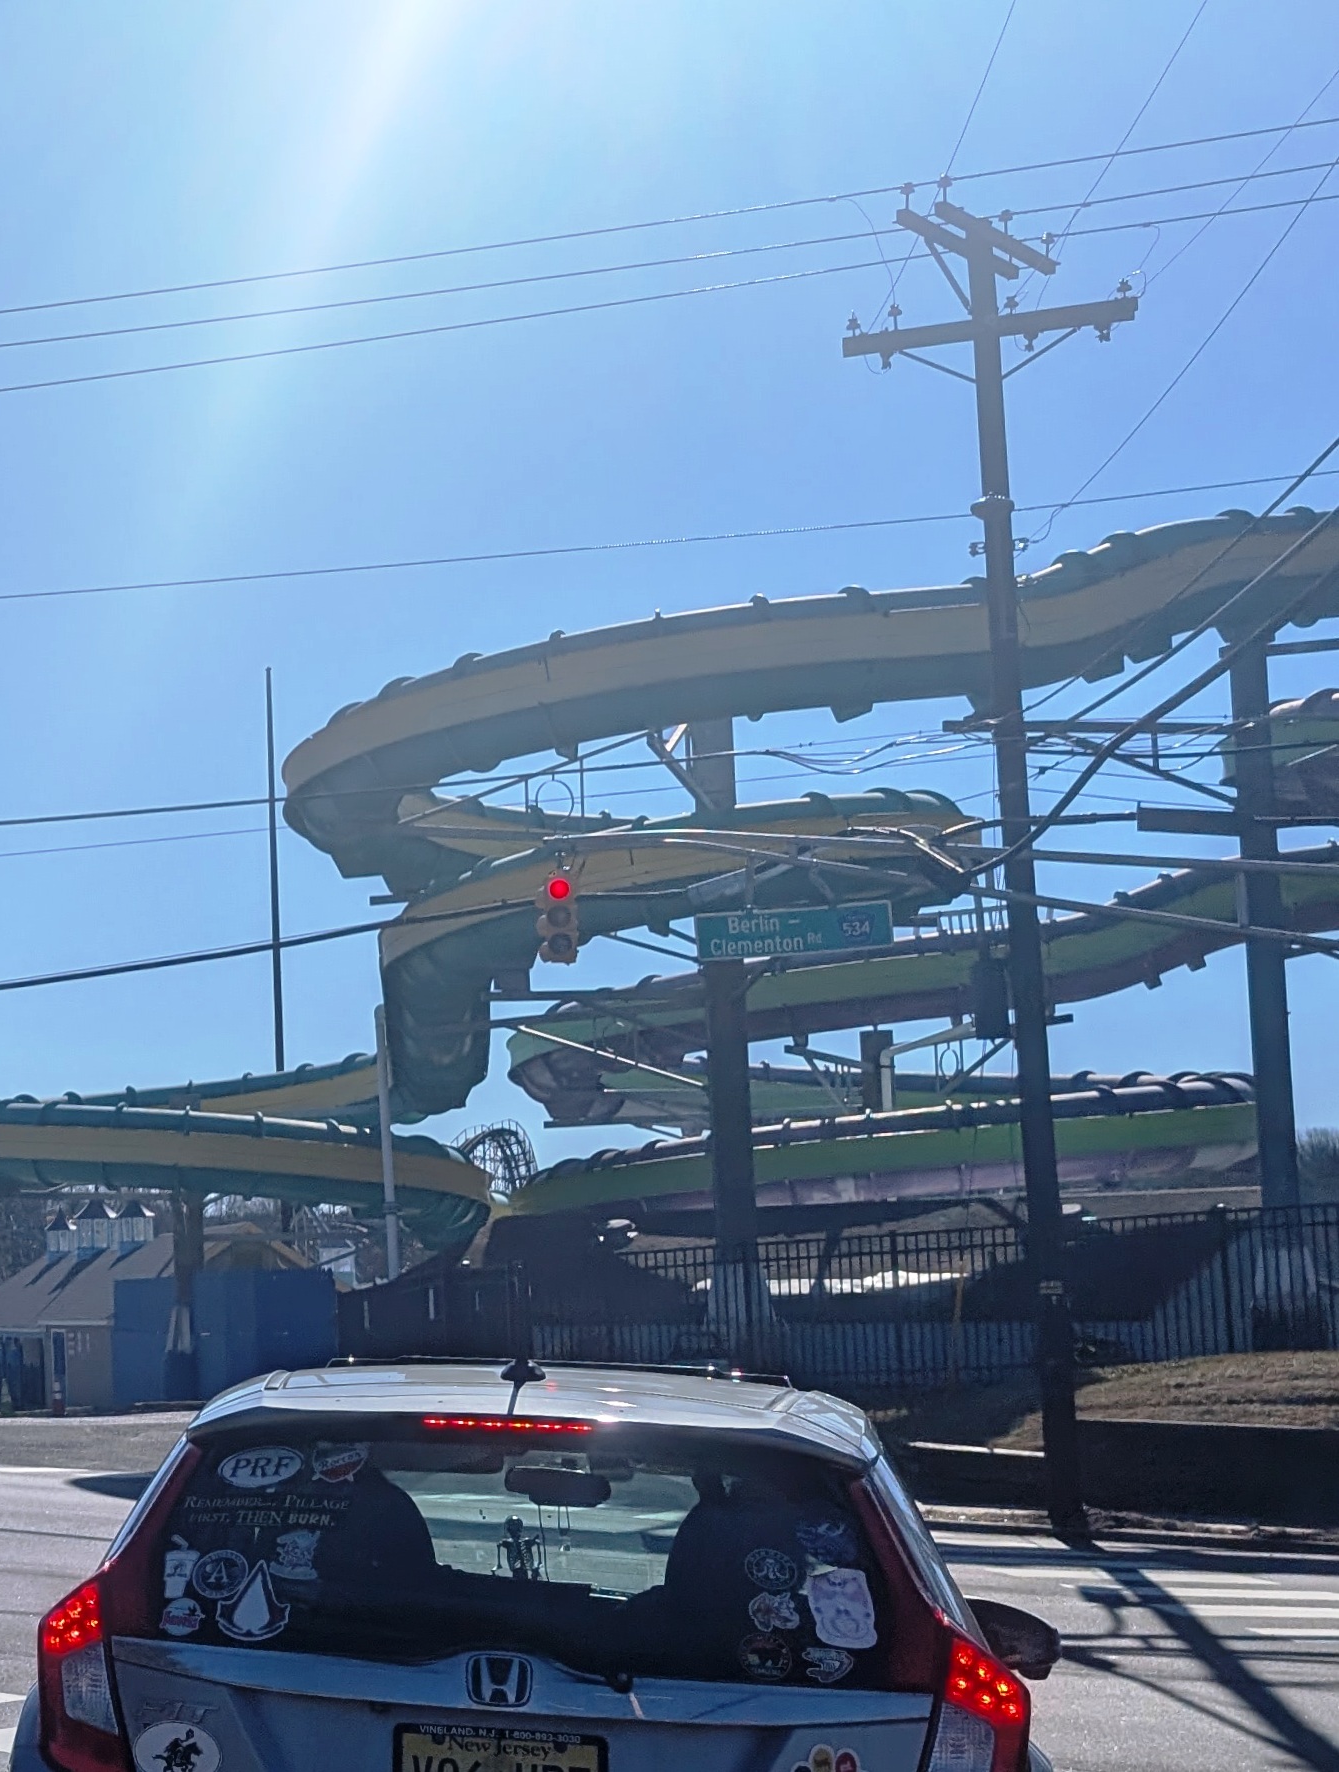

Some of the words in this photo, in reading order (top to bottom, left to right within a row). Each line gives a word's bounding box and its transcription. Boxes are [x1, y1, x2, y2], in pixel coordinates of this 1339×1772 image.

[727, 915, 780, 934] Berlin
[842, 920, 870, 937] 534
[710, 936, 804, 956] Clementon
[807, 932, 822, 944] Rd
[228, 1455, 295, 1479] PRF
[208, 1561, 229, 1583] A
[448, 1736, 490, 1752] New
[494, 1737, 552, 1761] Jersey
